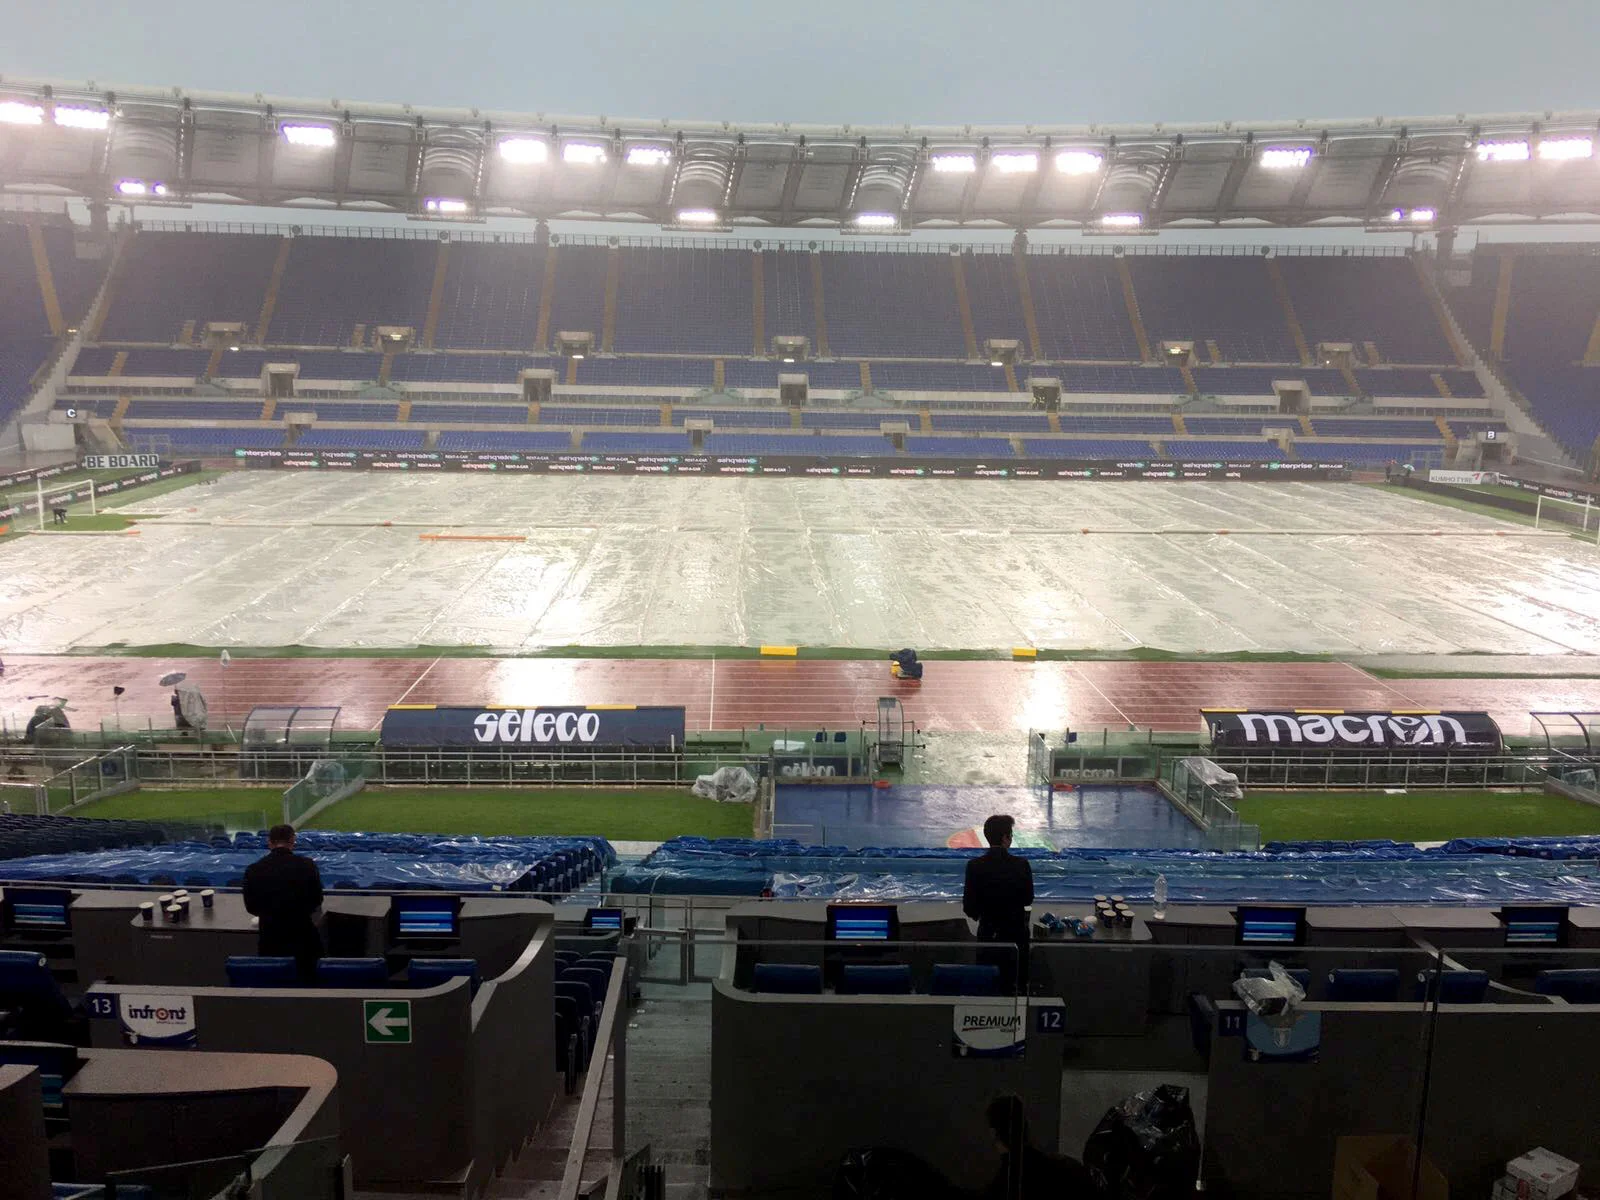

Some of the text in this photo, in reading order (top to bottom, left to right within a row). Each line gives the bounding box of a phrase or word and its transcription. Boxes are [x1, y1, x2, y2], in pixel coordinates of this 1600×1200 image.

[87, 456, 105, 468] BE
[109, 455, 159, 468] BOARD
[1237, 713, 1467, 743] macron
[92, 999, 112, 1014] 13
[128, 1004, 187, 1020] infront
[963, 1015, 1021, 1026] PREMIUM
[1041, 1012, 1062, 1028] 12
[1225, 1016, 1240, 1029] 11
